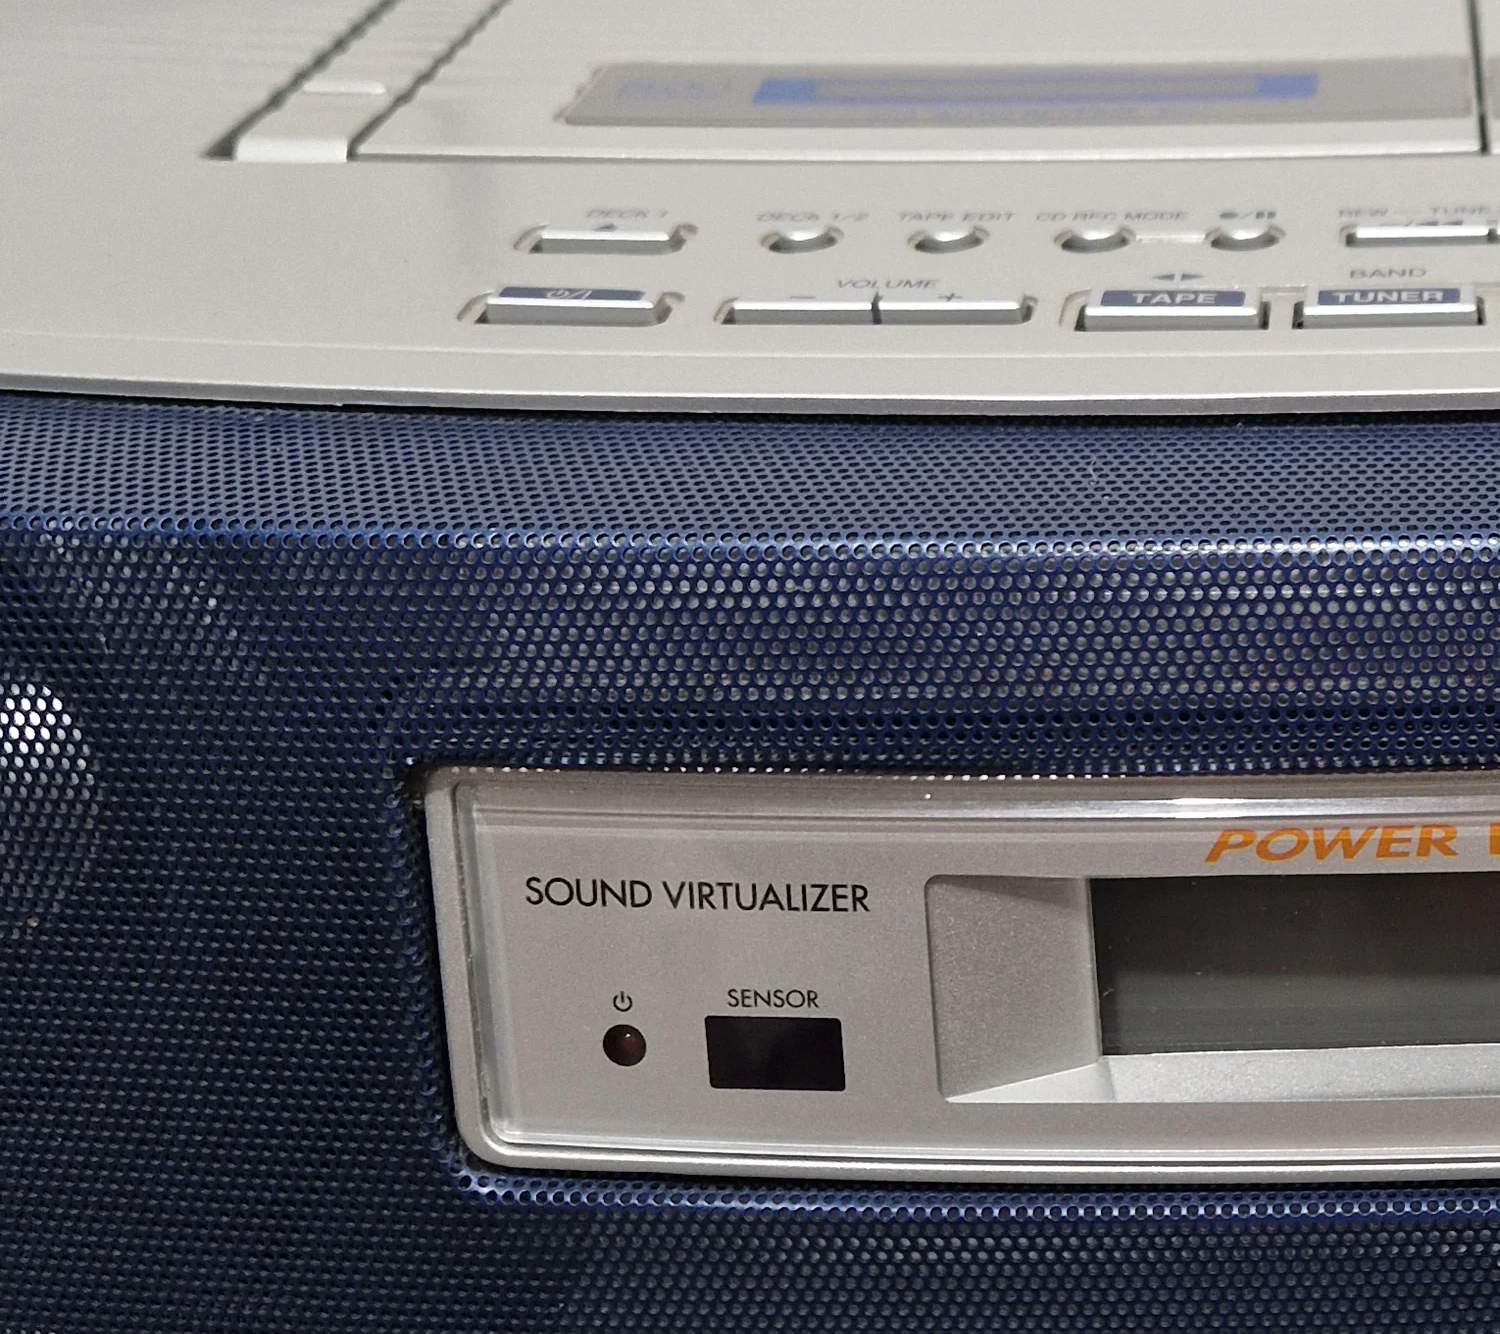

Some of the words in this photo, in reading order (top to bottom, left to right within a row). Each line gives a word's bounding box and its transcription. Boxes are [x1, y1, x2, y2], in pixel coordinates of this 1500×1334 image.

[900, 211, 956, 222] TAPE
[962, 211, 1016, 222] EDIT
[1035, 211, 1066, 222] CD
[1123, 211, 1189, 222] MODE
[1349, 267, 1427, 280] BAND
[837, 278, 941, 290] VOLUME
[1132, 292, 1217, 306] TAPE
[1333, 290, 1444, 304] TUNER
[1205, 823, 1459, 863] POWER
[525, 876, 654, 909] SOUND
[662, 880, 871, 913] VIRTUALIZER
[727, 988, 820, 1009] SENSOR
